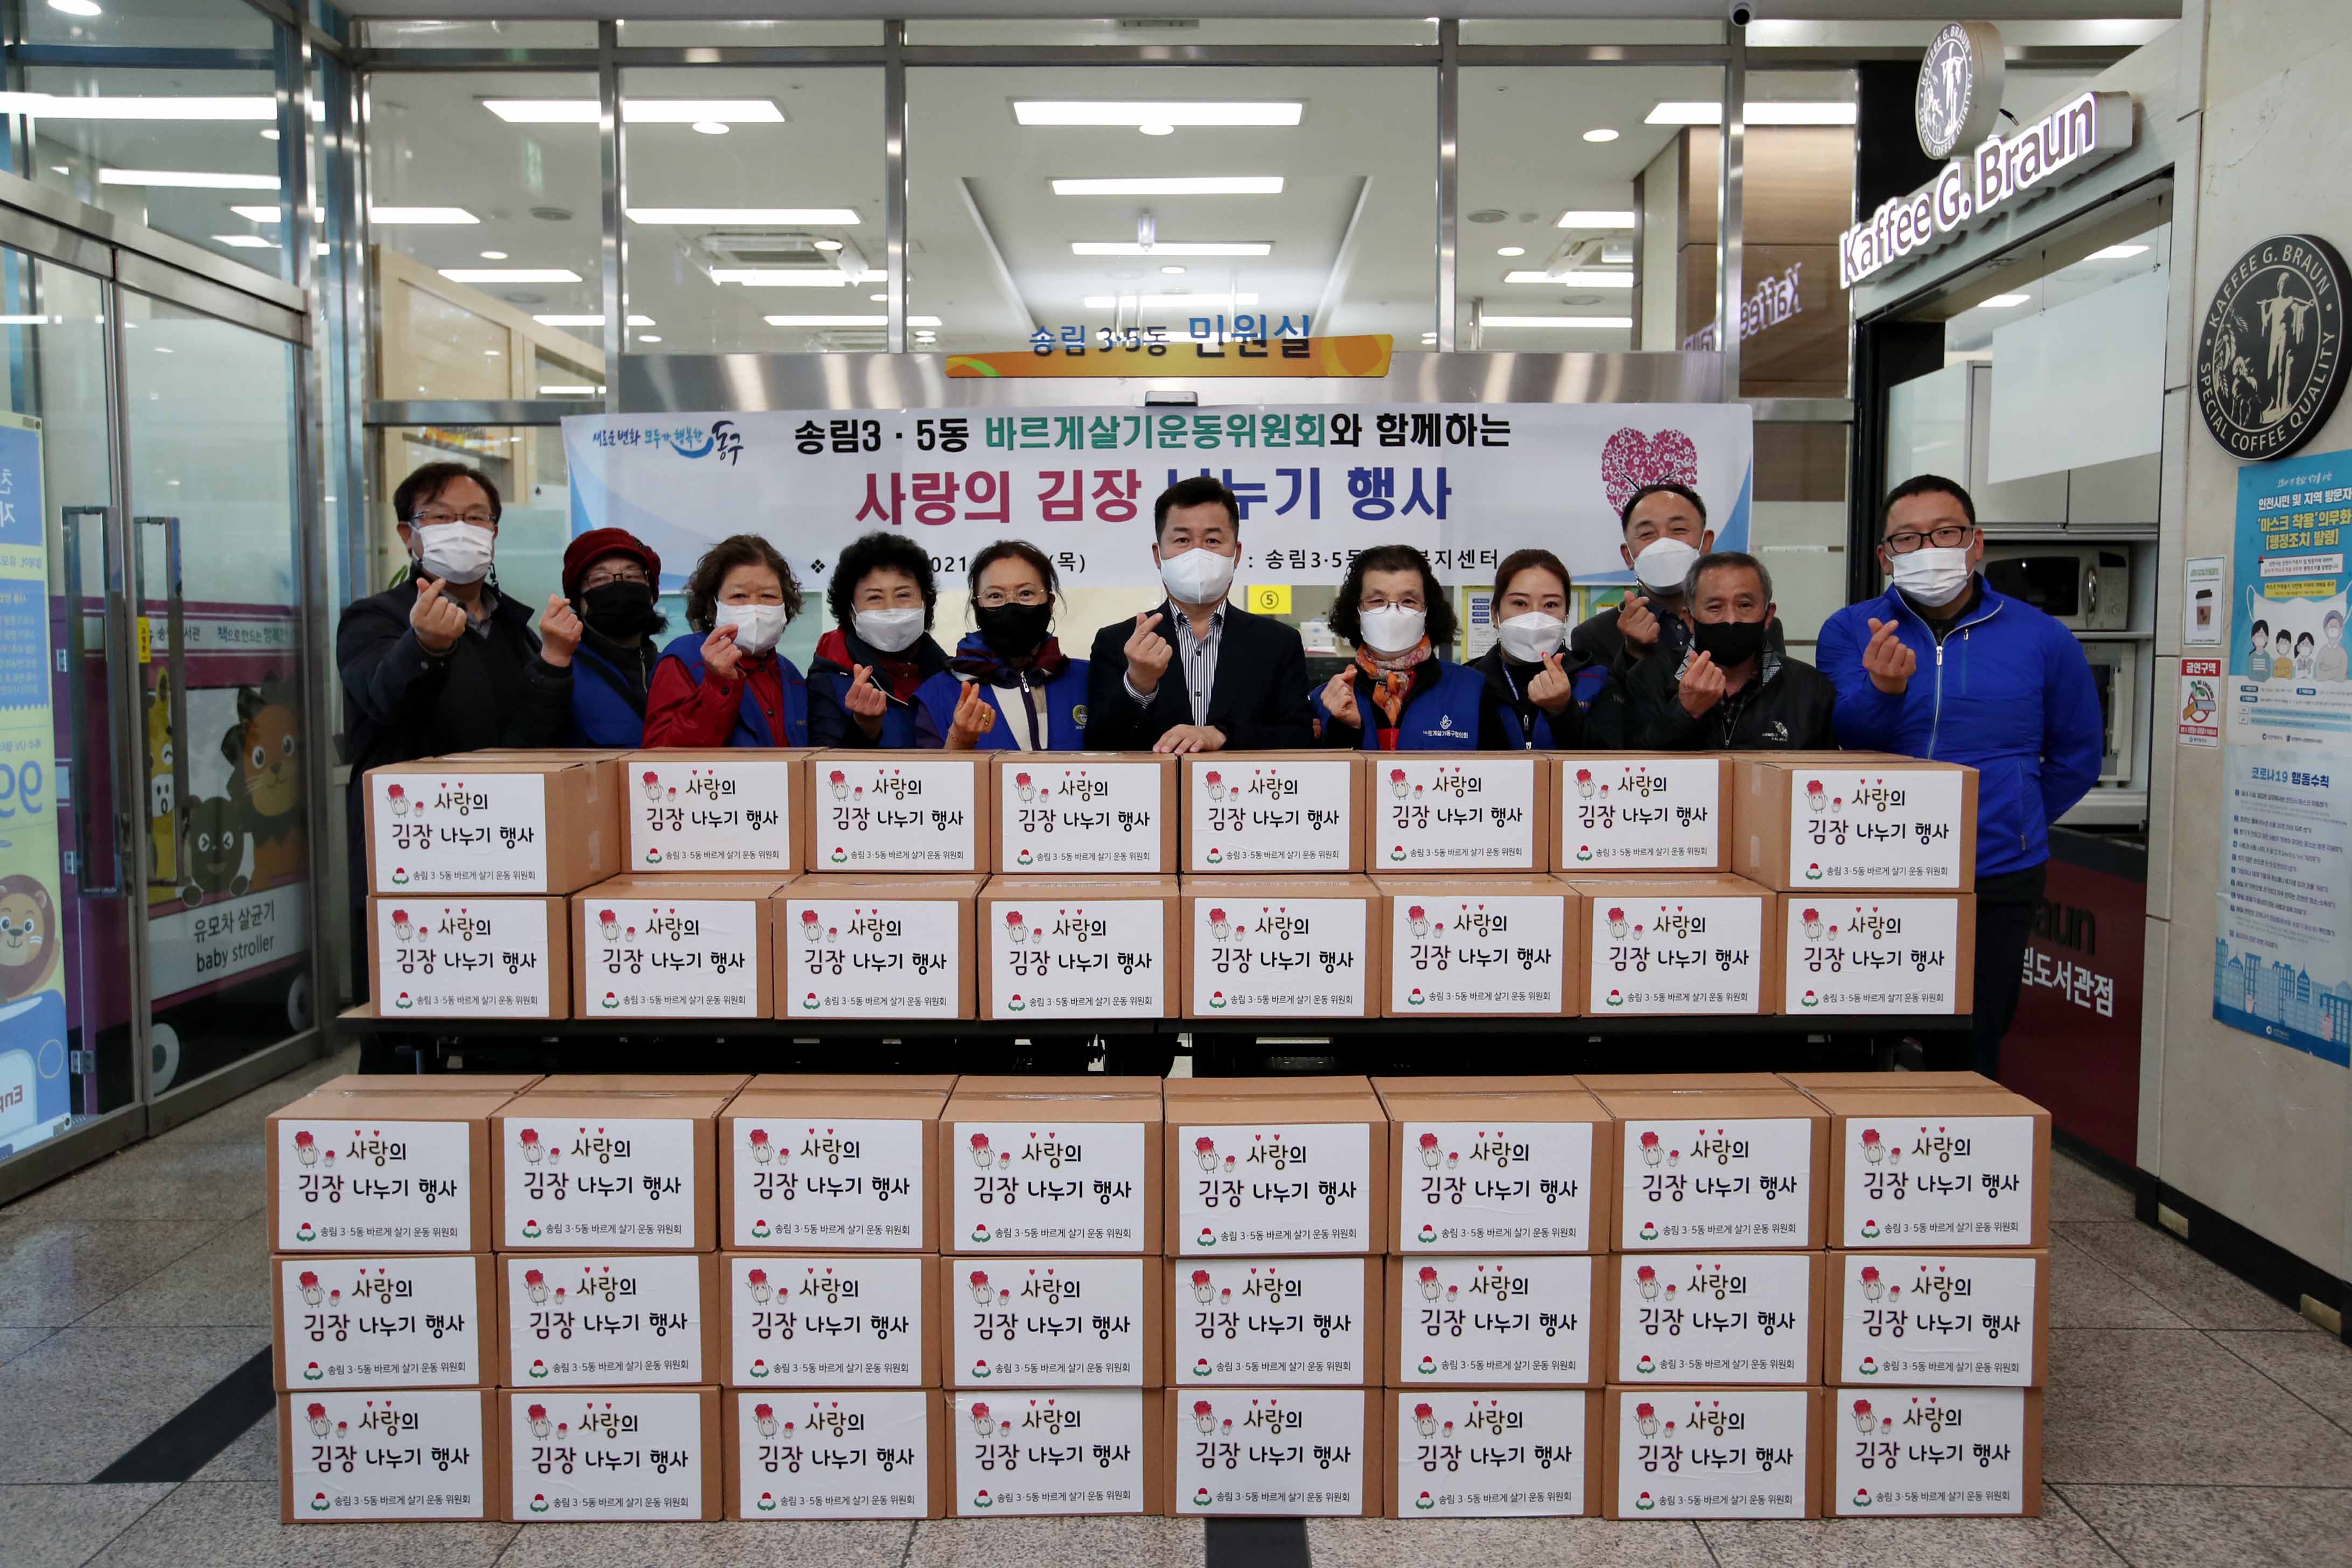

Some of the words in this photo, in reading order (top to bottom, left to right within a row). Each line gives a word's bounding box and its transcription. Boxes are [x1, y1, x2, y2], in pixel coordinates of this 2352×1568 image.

[1921, 36, 1941, 86] KAFFEE
[1943, 29, 1950, 40] G.
[1950, 26, 1971, 53] BRAUN
[1919, 108, 1932, 153] SPECIAL
[1933, 136, 1956, 156] COFFEE
[1956, 73, 1972, 135] QUALITY
[1840, 194, 1932, 288] Kaffee
[1935, 163, 1971, 230] G.
[1976, 94, 2096, 213] Braun
[2209, 255, 2257, 328] KAFFEE
[2263, 247, 2278, 263] G.
[2283, 244, 2330, 296] BRAUN
[1029, 325, 1085, 356] 송림
[1189, 314, 1310, 358] 민원실
[2201, 362, 2225, 439] SPECIAL
[2231, 426, 2286, 451] COFFEE
[2290, 331, 2335, 425] QUALITY
[645, 429, 671, 449] 모두가
[674, 426, 703, 450] 행복한
[986, 413, 1362, 450] 바르게살기운동위원회와
[1376, 413, 1510, 447] 함께하는
[855, 471, 1010, 525] 사랑의
[1038, 469, 1142, 523] 김장
[1167, 467, 1320, 520] 누기
[1348, 467, 1451, 521] 행사
[2259, 495, 2290, 510] 인천시민
[2292, 493, 2301, 506] 및
[2304, 491, 2322, 504] 지역
[2186, 662, 2216, 674] 금연구역
[1248, 778, 1298, 801] 사랑의
[2252, 767, 2288, 783] 코로나19
[2292, 772, 2329, 788] 행동수칙
[433, 792, 488, 816] 사랑의
[1208, 807, 1247, 831] 김장
[1253, 810, 1299, 828] 나누기
[1307, 809, 1340, 831] 행사
[392, 823, 433, 850] 김장
[440, 827, 491, 846] 나누기
[499, 825, 535, 849] 행사
[1226, 851, 1240, 860] 송림
[1242, 851, 1263, 860] 3·5동
[1264, 850, 1285, 859] 바르게
[1286, 850, 1300, 860] 살기
[1302, 850, 1317, 859] 운동
[1318, 850, 1339, 859] 위원회
[413, 871, 428, 881] 송림
[431, 871, 453, 881] 3·5동
[454, 870, 477, 880] 바르게
[478, 871, 494, 880] 살기
[495, 871, 511, 881] 운동
[513, 870, 535, 880] 위원회
[194, 911, 234, 943] 유모차
[239, 900, 274, 930] 살균기
[645, 918, 699, 942] 사랑의
[1847, 916, 1901, 940] 사랑의
[198, 948, 228, 972] baby
[233, 934, 274, 962] stroller
[603, 948, 645, 975] 김장
[652, 952, 702, 971] 나누기
[710, 951, 746, 975] 행사
[1804, 947, 1845, 973] 김장
[1852, 950, 1902, 970] 나누기
[1910, 949, 1945, 972] 행사
[623, 995, 638, 1005] 송림
[640, 995, 662, 1005] 3·5동
[664, 995, 687, 1004] 바르게
[689, 995, 704, 1005] 살기
[706, 995, 721, 1005] 운동
[723, 995, 746, 1005] 위원회
[1822, 993, 1837, 1003] 송림
[1840, 993, 1861, 1003] 3·5동
[1863, 993, 1886, 1003] 바르게
[1887, 993, 1902, 1003] 살기
[1904, 993, 1920, 1003] 운동
[1921, 993, 1943, 1003] 위원회
[346, 1140, 407, 1167] 사랑의
[1690, 1139, 1749, 1166] 사랑의
[298, 1174, 345, 1203] 김장
[353, 1179, 409, 1200] 나누기
[418, 1178, 458, 1204] 행사
[1642, 1174, 1688, 1202] 김장
[1696, 1177, 1749, 1198] 나누기
[1759, 1175, 1797, 1201] 행사
[320, 1227, 337, 1237] 송림
[340, 1227, 365, 1237] 3·5동
[366, 1227, 392, 1237] 바르게
[394, 1227, 411, 1237] 살기
[413, 1227, 430, 1238] 운동
[432, 1227, 458, 1238] 위원회
[1662, 1225, 1679, 1236] 송림
[1681, 1224, 1705, 1236] 3·5동
[1707, 1224, 1732, 1235] 바르게
[1734, 1224, 1751, 1235] 살기
[1753, 1223, 1769, 1234] 운동
[1772, 1223, 1796, 1234] 위원회
[1020, 1279, 1080, 1305] 사랑의
[973, 1312, 1019, 1341] 김장
[1027, 1316, 1082, 1337] 나누기
[1091, 1315, 1131, 1340] 행사
[995, 1363, 1012, 1374] 송림
[1014, 1363, 1039, 1374] 3·5동
[1040, 1363, 1066, 1374] 바르게
[1068, 1362, 1084, 1374] 살기
[1086, 1363, 1103, 1374] 운동
[1105, 1362, 1130, 1373] 위원회
[1464, 1410, 1523, 1436] 사랑의
[1417, 1444, 1463, 1473] 김장
[1470, 1446, 1524, 1467] 나누기
[1534, 1445, 1572, 1469] 행사
[1438, 1494, 1455, 1505] 송림
[1458, 1494, 1481, 1504] 3·5동
[1483, 1493, 1508, 1504] 바르게
[1510, 1492, 1526, 1503] 살기
[1528, 1492, 1545, 1502] 운동
[1547, 1491, 1572, 1502] 위원회
